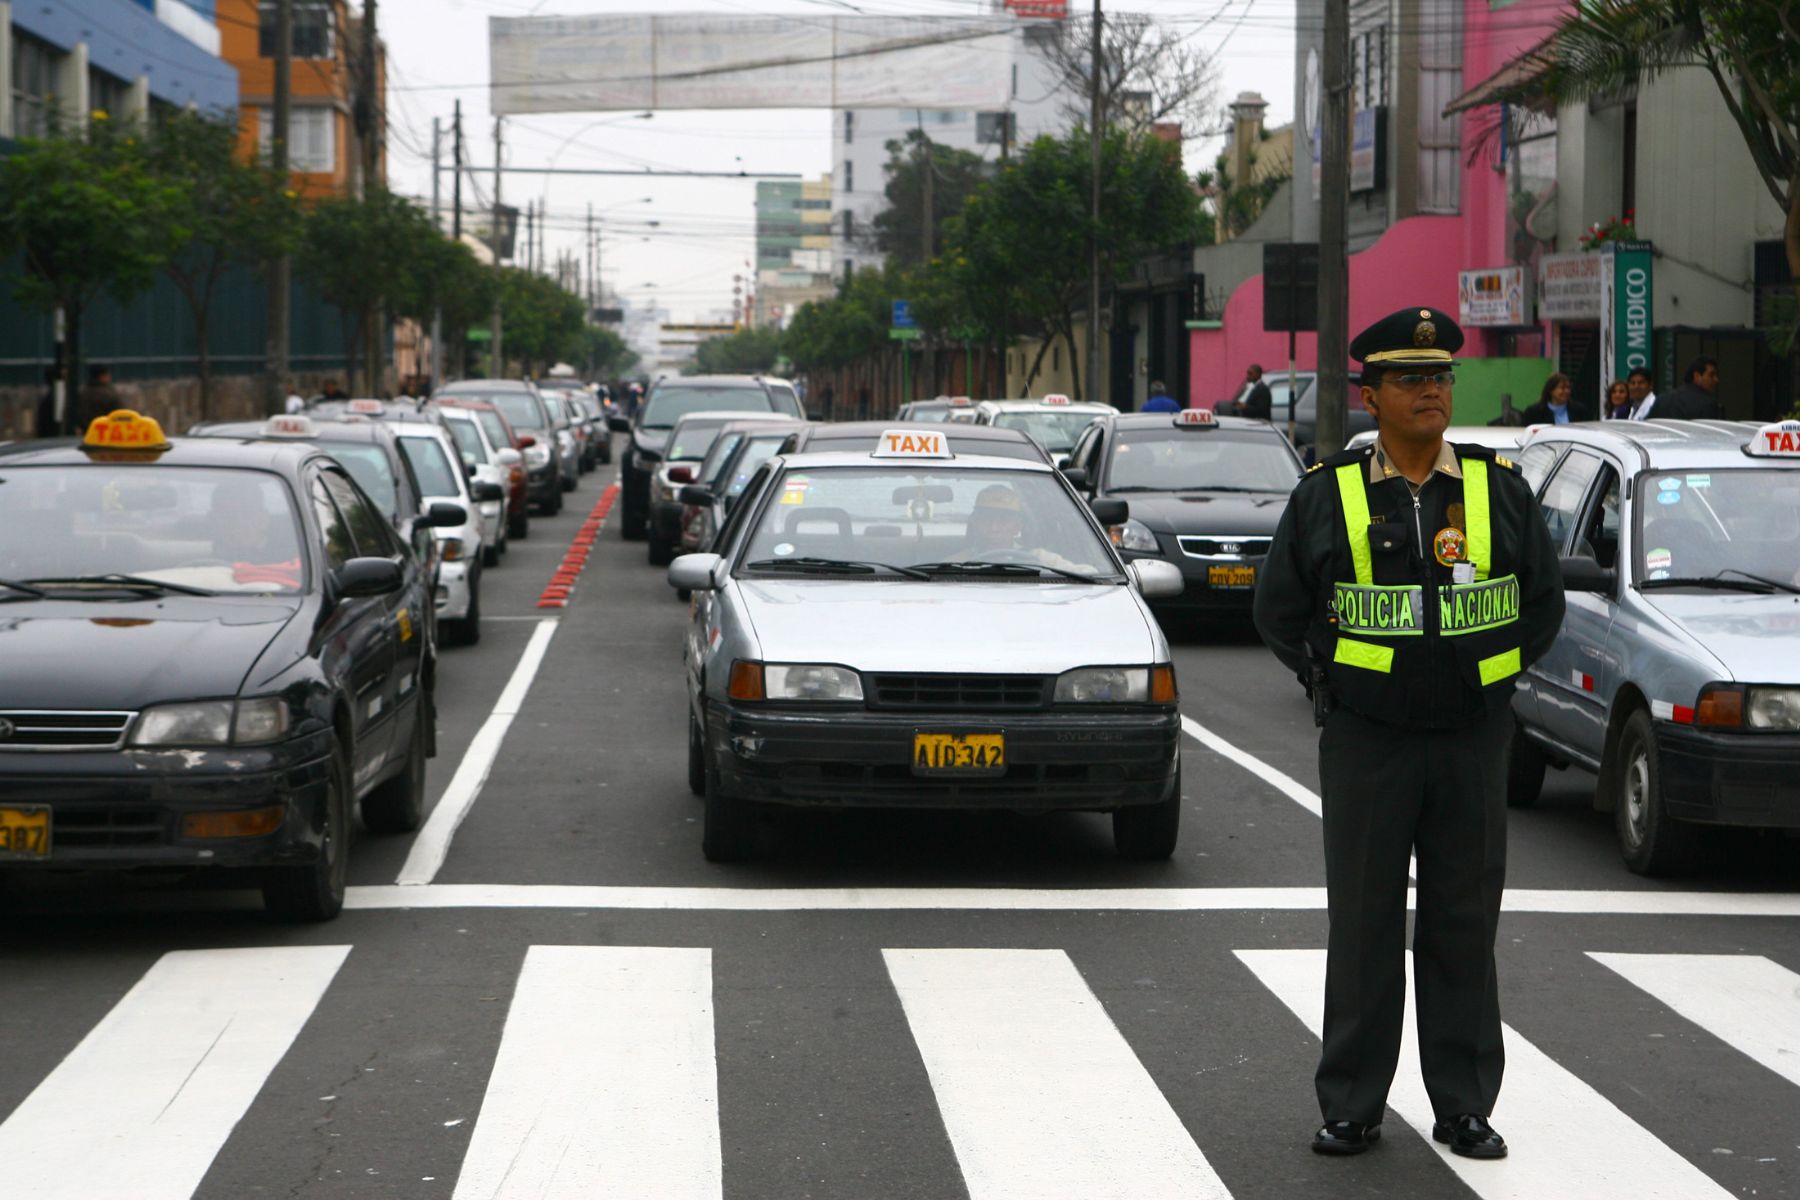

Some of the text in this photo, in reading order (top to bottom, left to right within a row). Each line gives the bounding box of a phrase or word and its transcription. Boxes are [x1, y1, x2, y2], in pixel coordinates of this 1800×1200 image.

[1626, 267, 1647, 349] MEDICO
[1184, 412, 1211, 423] TAXI
[95, 423, 151, 442] TAXI
[886, 434, 939, 453] TAXI
[1336, 588, 1415, 628] POLICIA
[1440, 583, 1517, 629] NACIONAL
